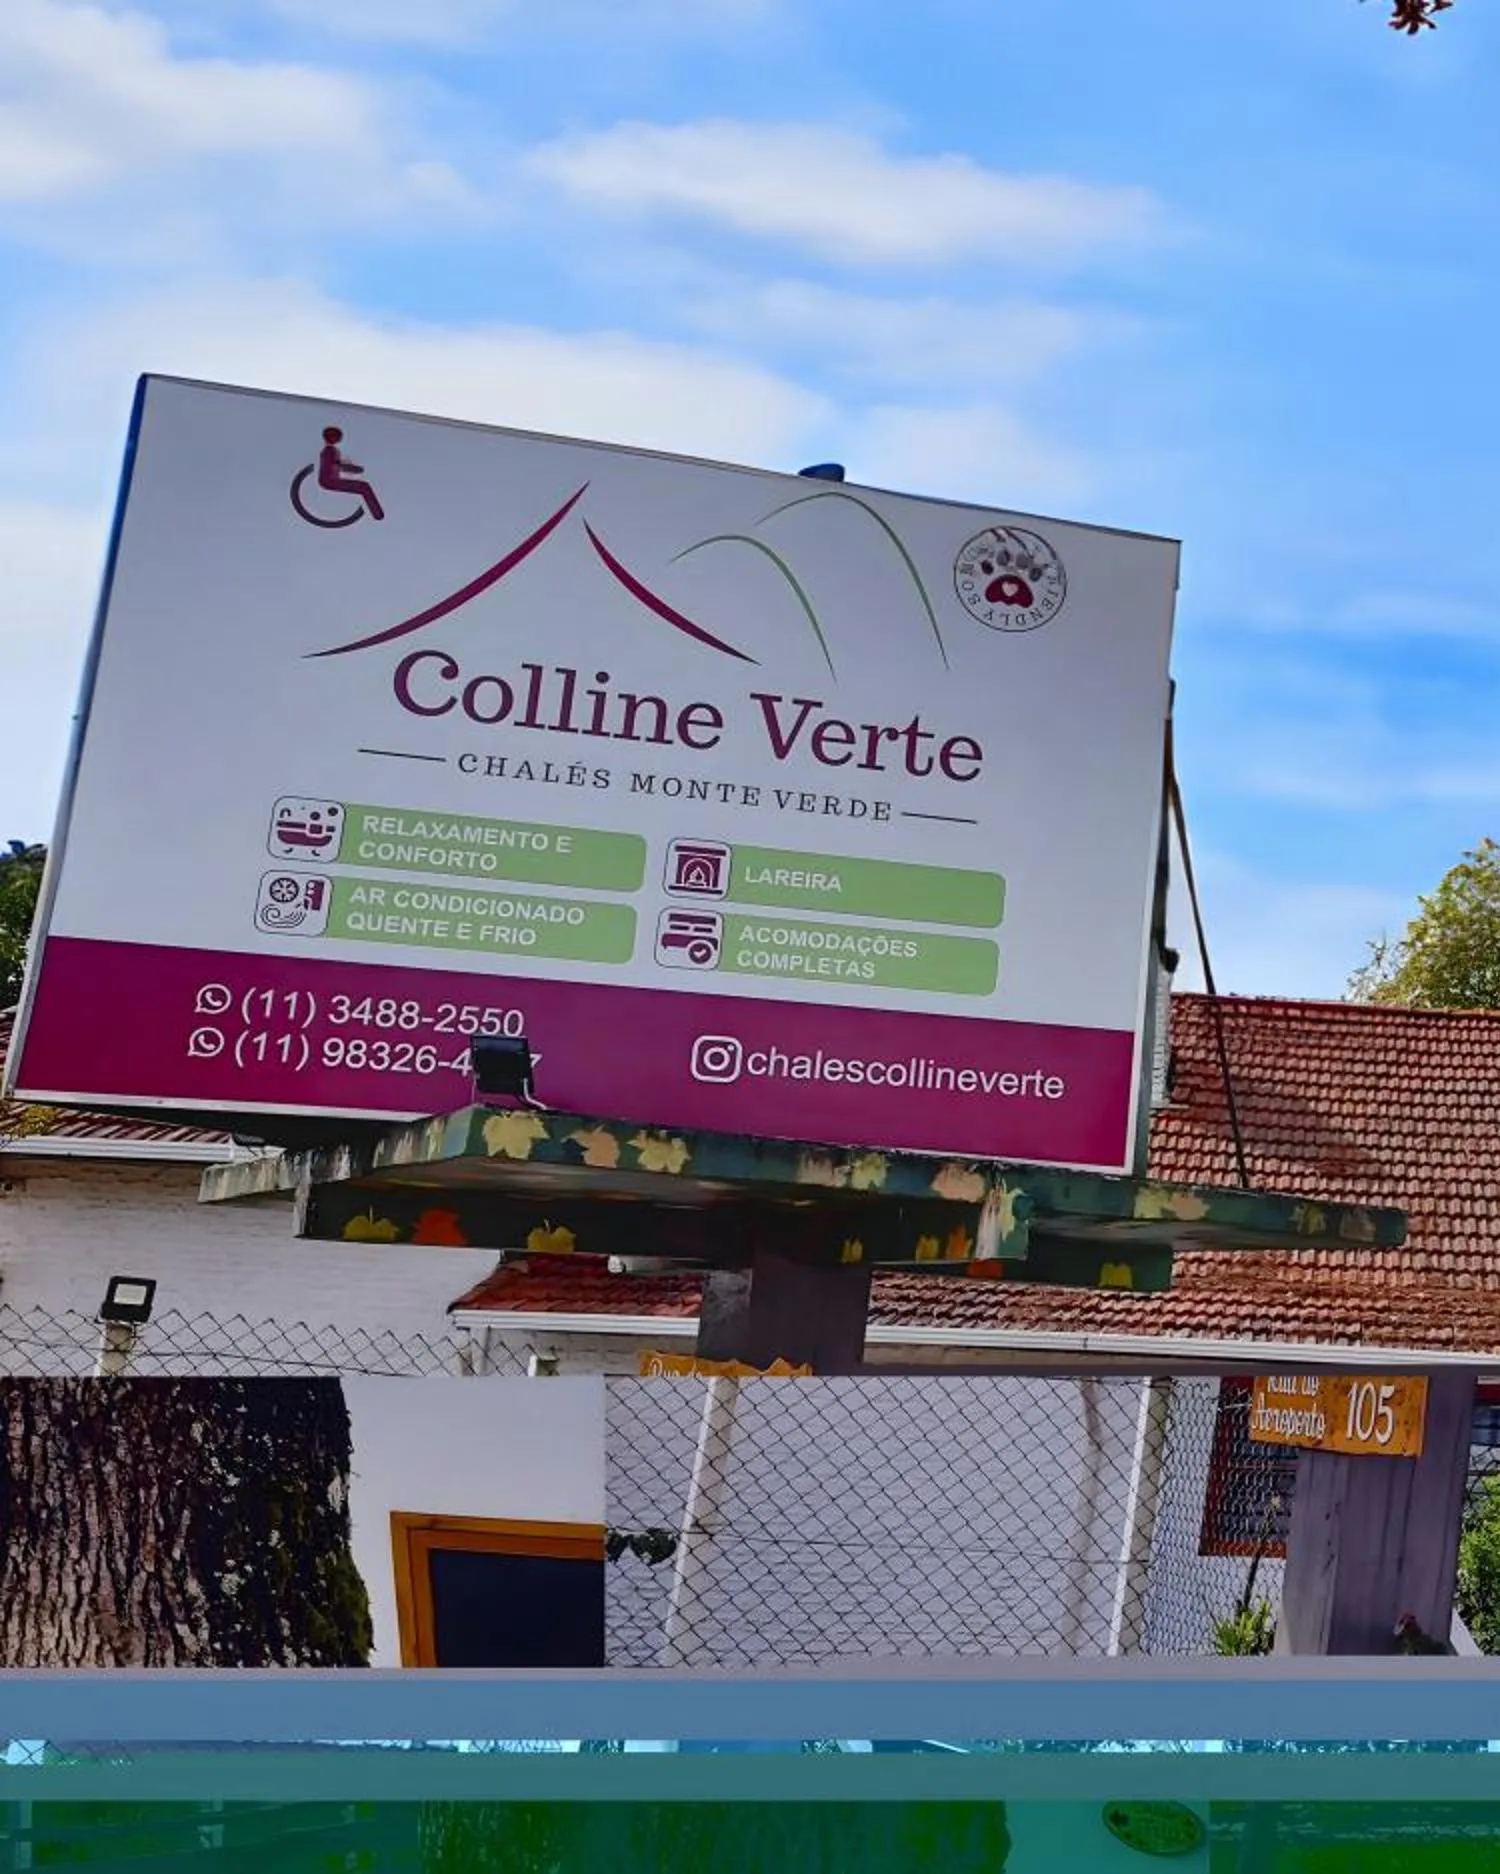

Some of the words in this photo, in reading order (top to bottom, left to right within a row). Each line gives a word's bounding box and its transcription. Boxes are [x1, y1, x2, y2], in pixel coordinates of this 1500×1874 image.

[393, 650, 723, 749] Colline
[750, 693, 982, 782] Verte
[457, 753, 611, 788] CHALÉS
[630, 773, 761, 806] MONTE
[772, 789, 892, 821] VERDE
[363, 815, 549, 851] RELAXAMENTO
[556, 837, 573, 853] E
[359, 841, 497, 871] CONFORTO
[745, 867, 842, 892] LAREIRA
[349, 886, 385, 905] AR
[394, 889, 585, 925] CONDICIONADO
[347, 911, 449, 937] QUENTE
[457, 922, 473, 939] E
[480, 925, 537, 945] FRIO
[738, 926, 918, 958] ACOMODAÇÕES
[737, 949, 876, 978] COMPLETAS
[241, 987, 316, 1028] (11)
[328, 995, 524, 1037] 3488-2550
[234, 1030, 310, 1071] (11)
[747, 1046, 1065, 1098] chalescollineverte
[1346, 1381, 1395, 1444] 105
